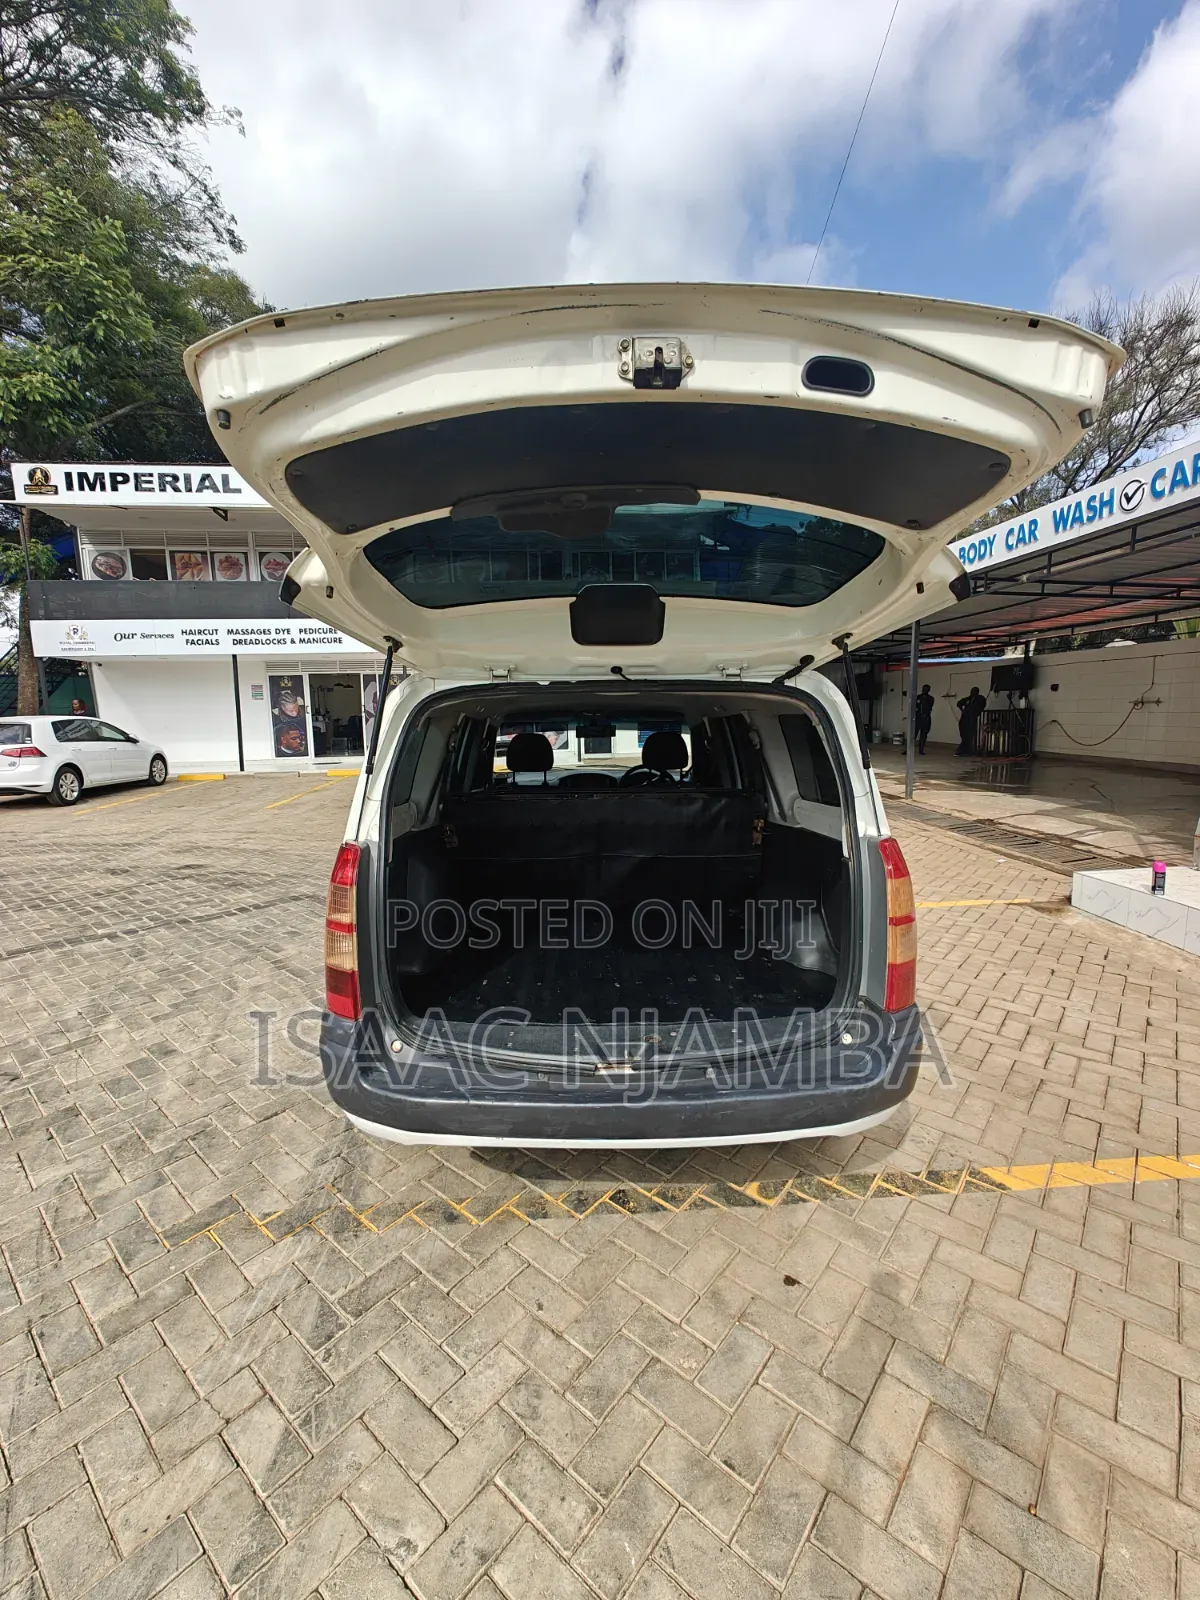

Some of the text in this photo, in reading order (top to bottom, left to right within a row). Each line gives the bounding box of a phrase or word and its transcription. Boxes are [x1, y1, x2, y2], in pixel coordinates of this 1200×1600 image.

[64, 471, 242, 494] IMPERIAL
[959, 533, 997, 565] BODY
[1005, 518, 1039, 551] CAR
[1052, 487, 1115, 534] WASH
[181, 628, 219, 636] HAIRCUT
[227, 628, 272, 636] MASSAGES
[299, 627, 338, 635] PEDICURE
[114, 632, 175, 642] Our Services
[185, 636, 343, 646] FACIALS DREADLOCKS & MANICURE
